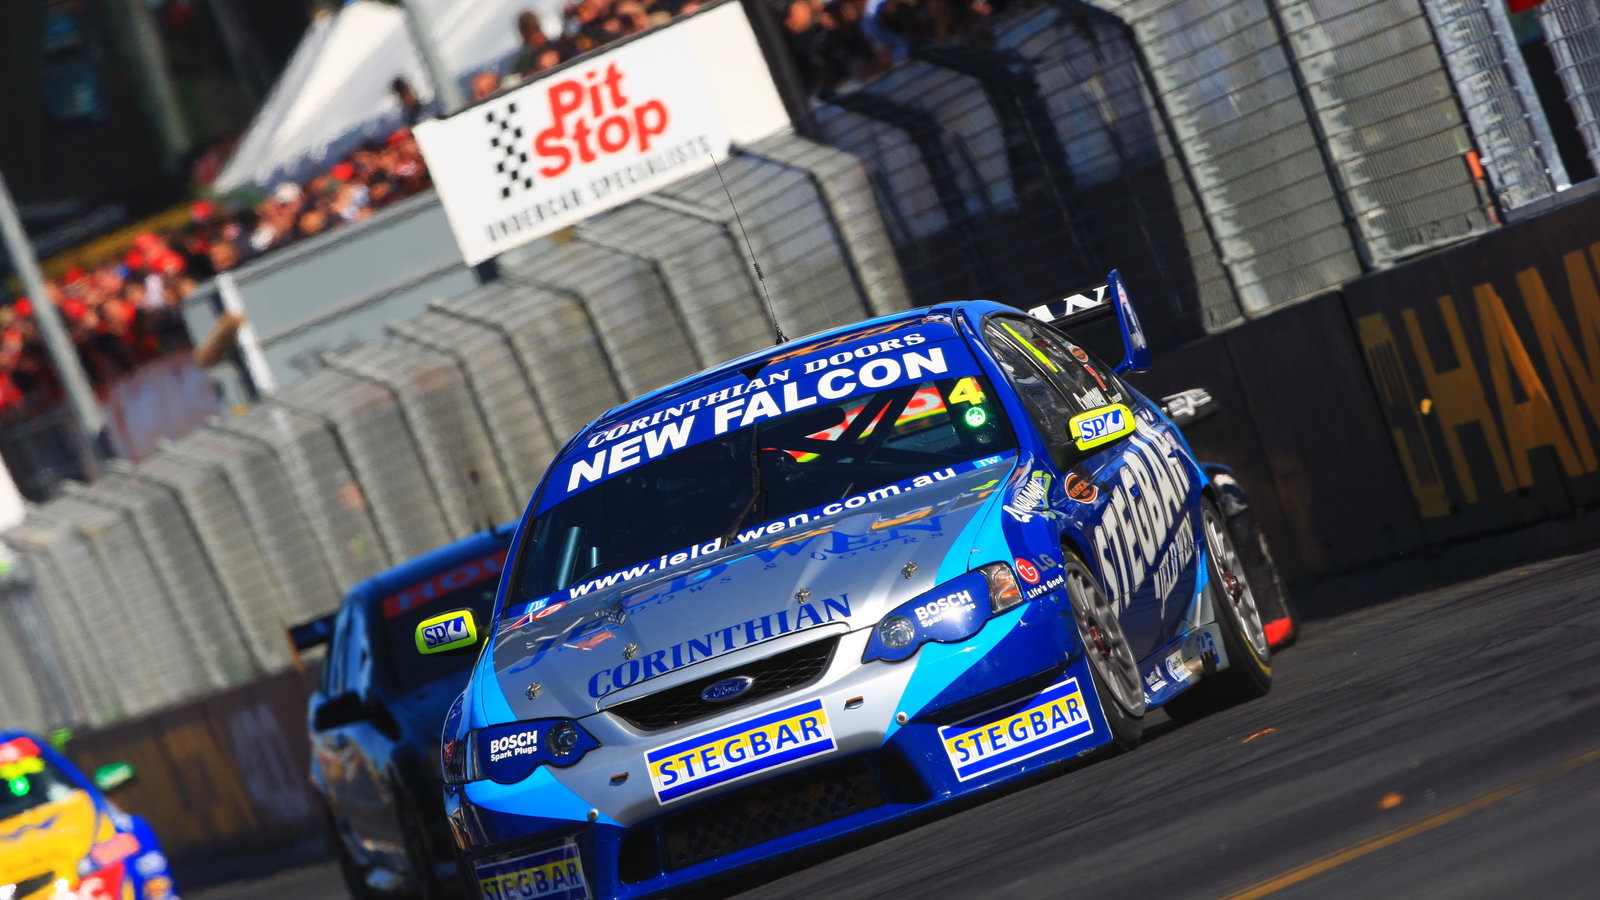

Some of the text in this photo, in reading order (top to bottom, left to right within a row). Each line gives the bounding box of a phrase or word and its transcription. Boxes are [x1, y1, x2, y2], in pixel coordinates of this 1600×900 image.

[548, 60, 627, 137] Pit
[534, 99, 668, 178] Stop
[587, 333, 926, 449] CORINTHIAN DOORS
[948, 376, 985, 405] 4
[566, 347, 948, 493] NEW FALCON
[1026, 575, 1064, 599] Life's Good
[1036, 553, 1057, 572] LG
[914, 589, 973, 621] BOSCH
[587, 593, 852, 699] CORINTHIAN
[490, 730, 538, 754] BOSCH
[490, 745, 537, 762] Spark Plugs
[658, 715, 823, 787] STEGBAR
[953, 697, 1084, 763] STEGBAR
[483, 861, 580, 900] STEGBAR
